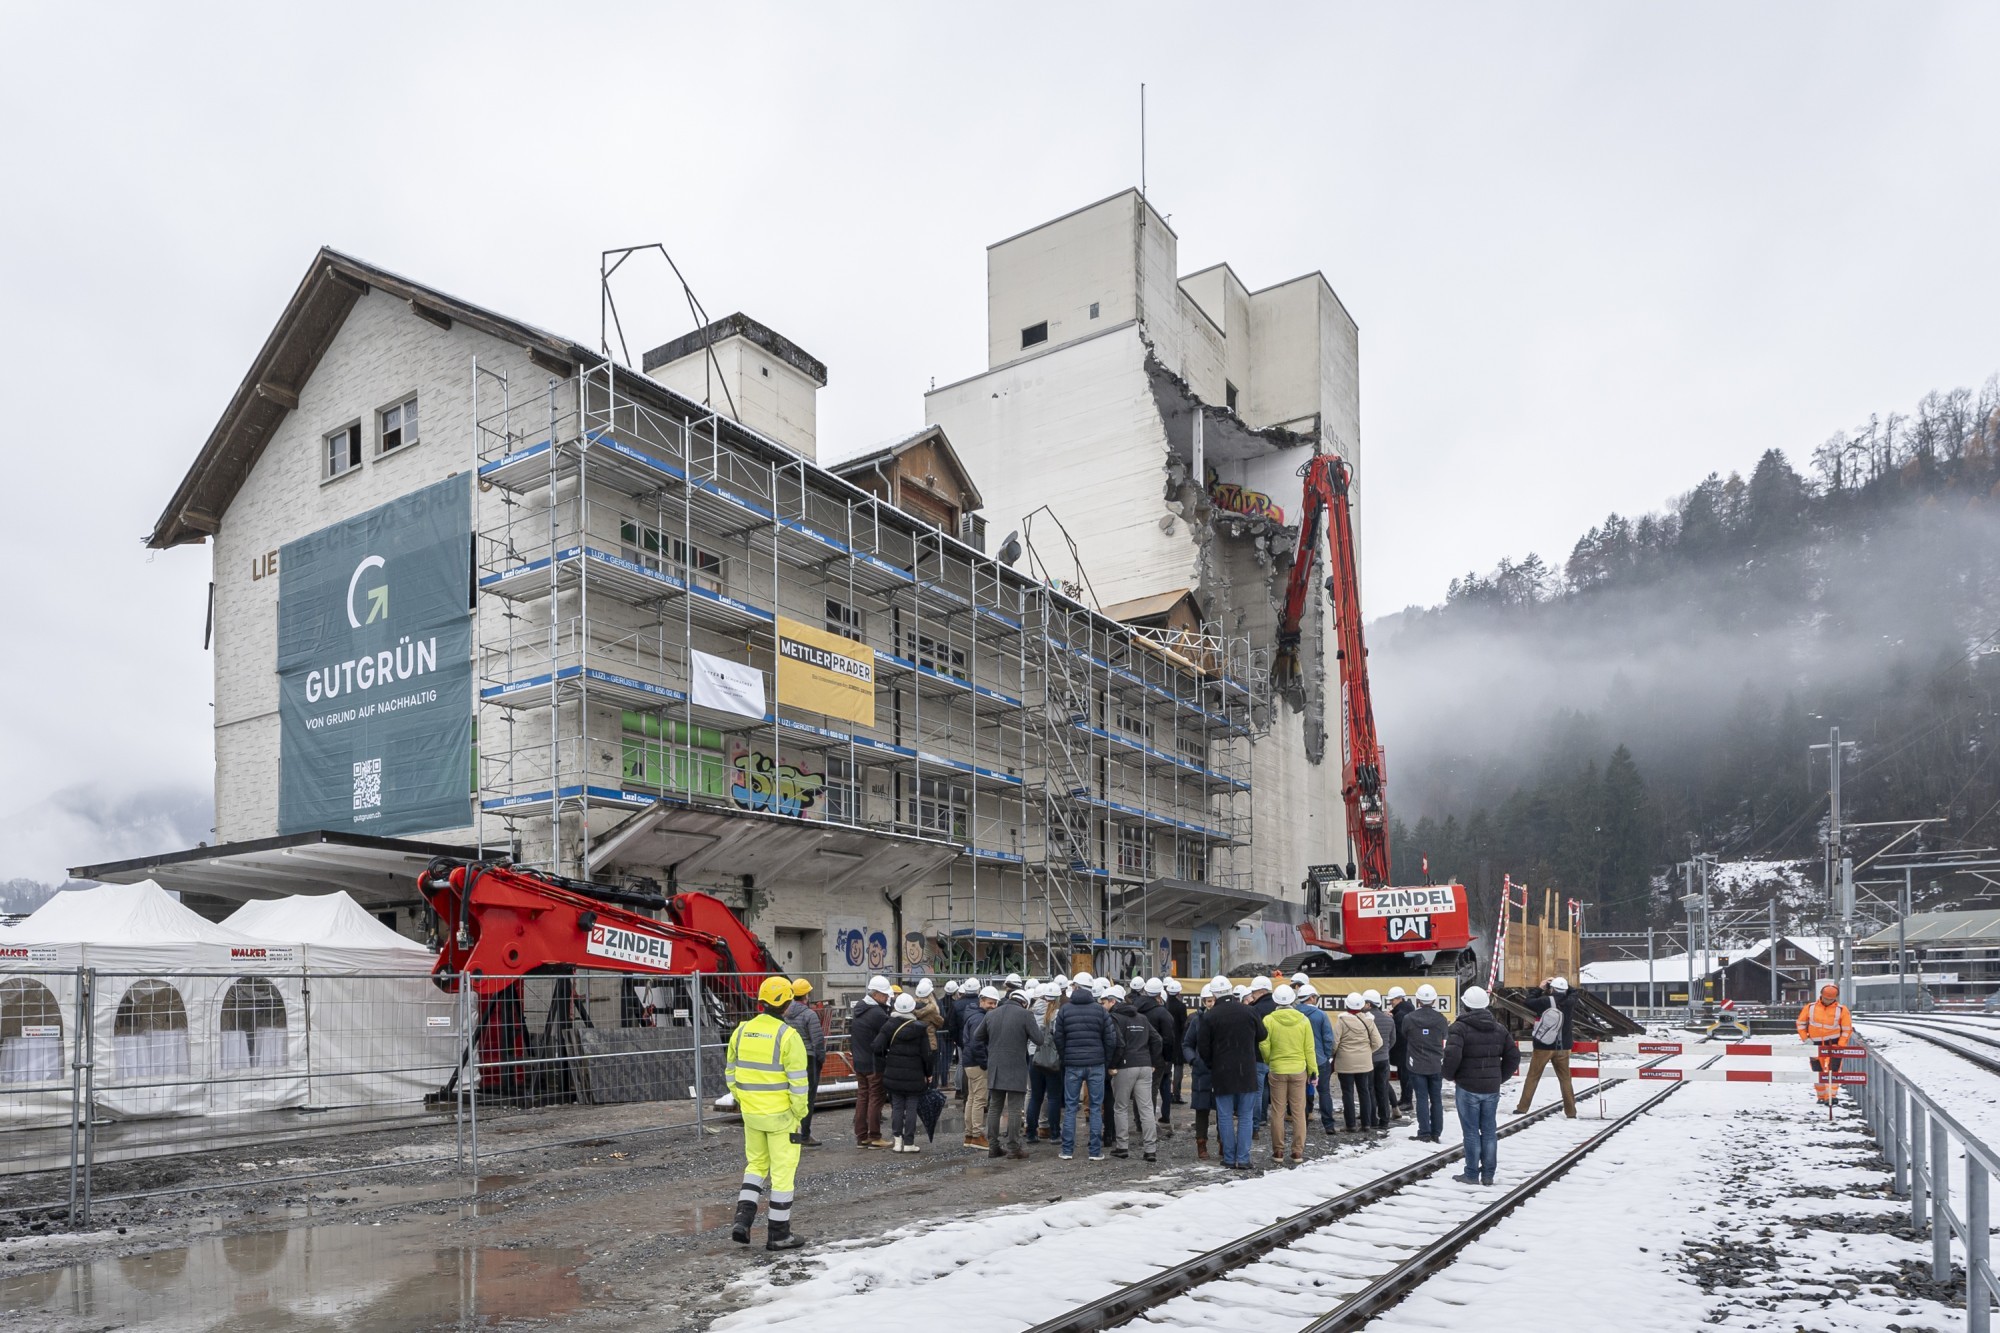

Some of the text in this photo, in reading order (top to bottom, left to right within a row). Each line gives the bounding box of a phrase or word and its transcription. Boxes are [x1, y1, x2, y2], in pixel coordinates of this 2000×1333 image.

[591, 550, 604, 560] LUZI
[781, 639, 870, 680] METTLER PRADER
[305, 635, 437, 703] GUTGRÜN
[592, 670, 606, 680] LUZI
[305, 690, 437, 730] VON GRUND AUF NACHHALTIG
[622, 792, 636, 801] Luzi
[1376, 890, 1453, 908] ZINDEL
[1377, 905, 1454, 915] BAUTWERTE
[1389, 916, 1429, 941] CAT
[0, 948, 28, 958] ALKER
[231, 948, 266, 958] WALKER
[606, 928, 669, 960] ZINDEL
[604, 948, 669, 968] BAUTWERTE
